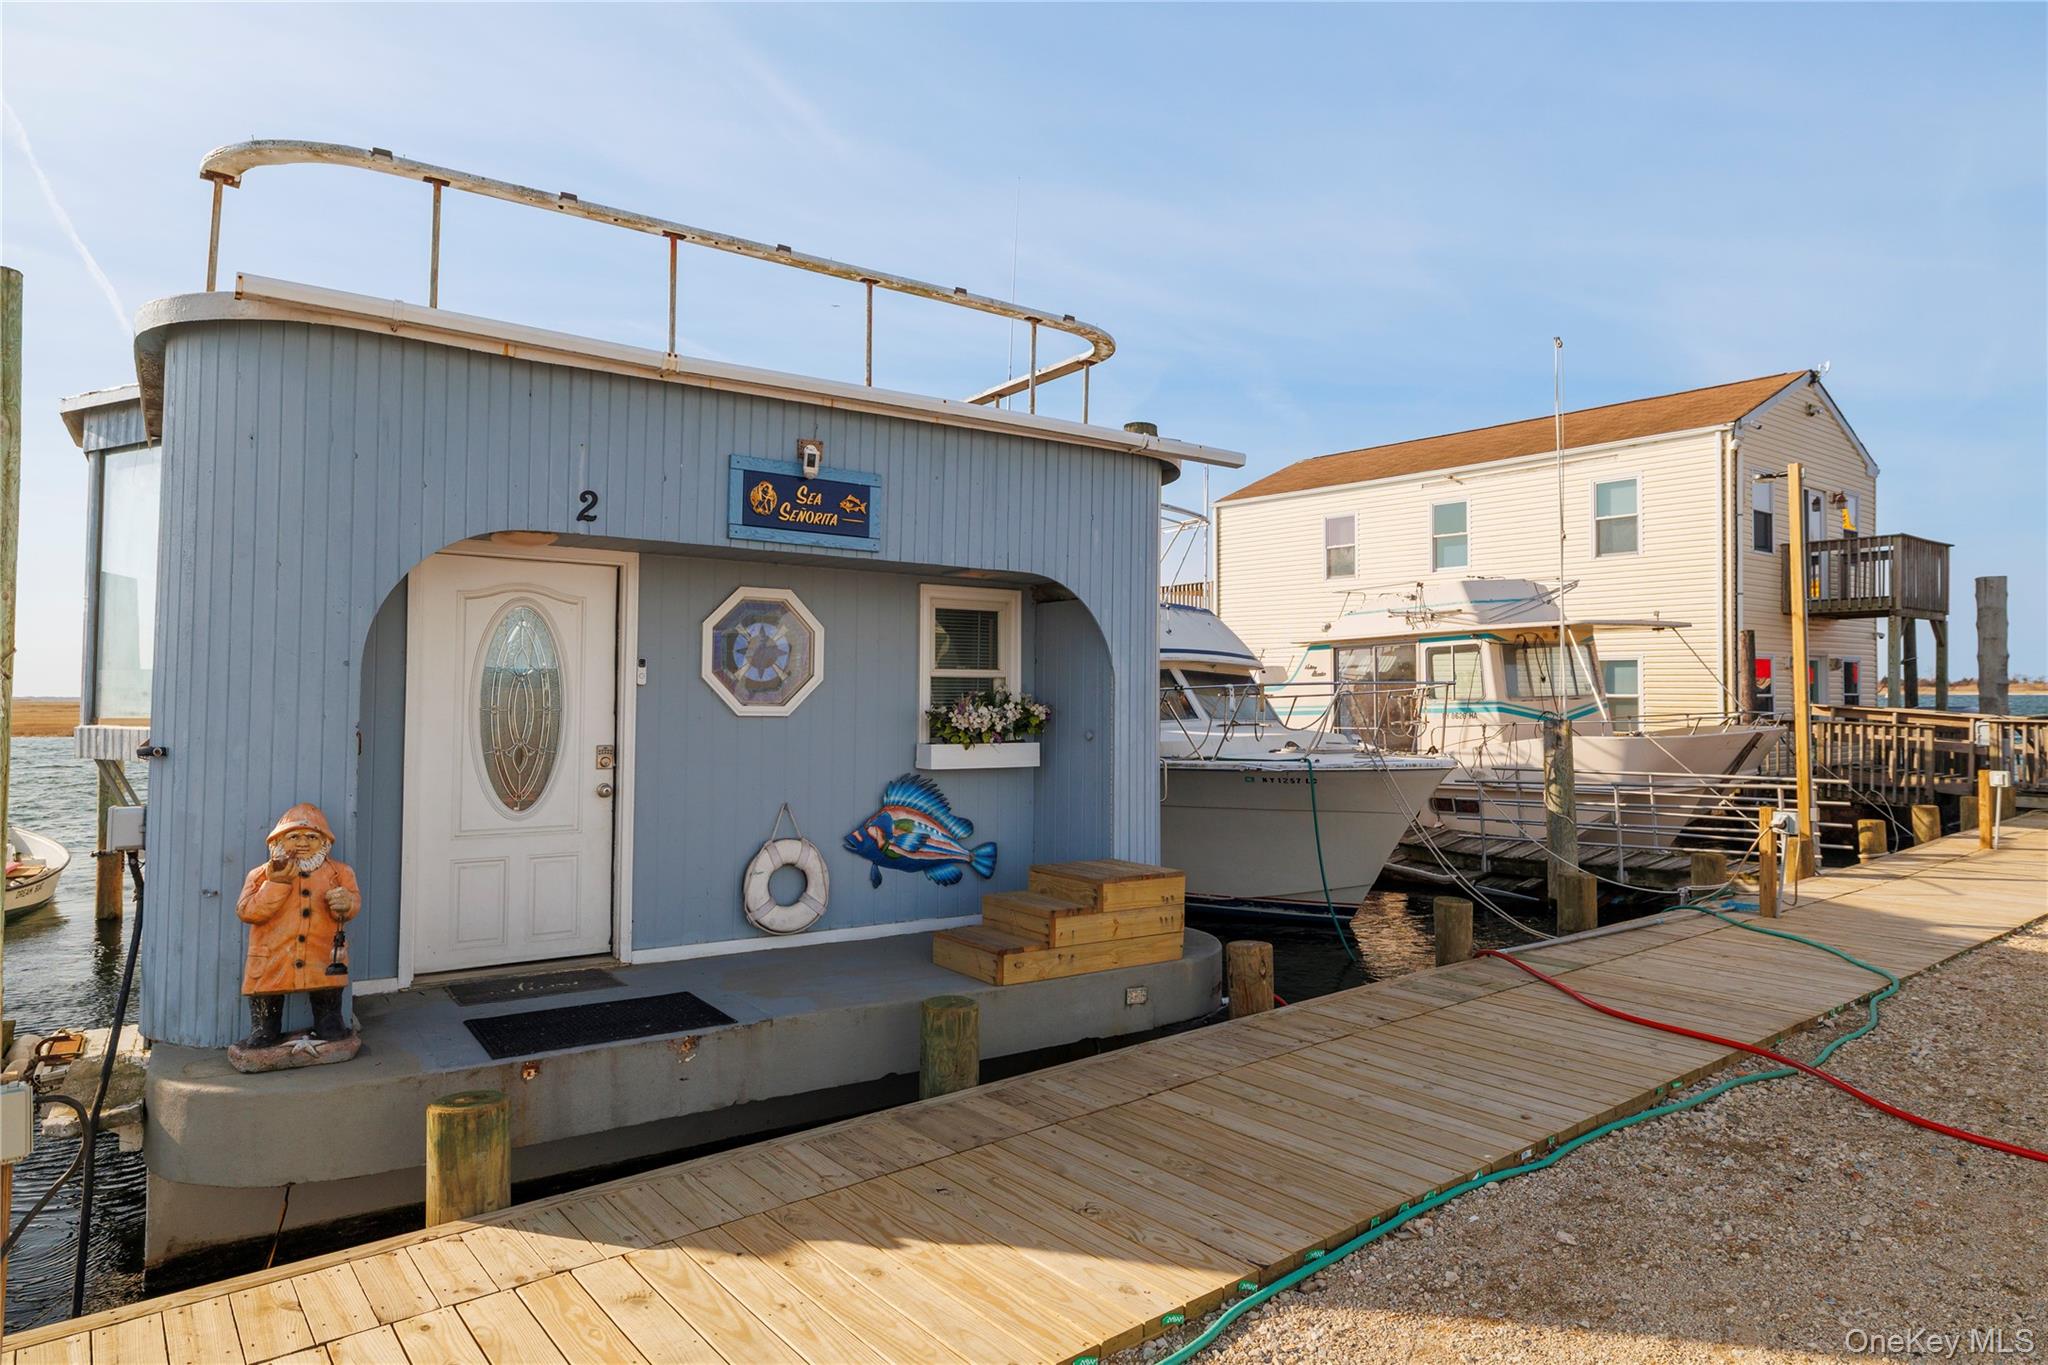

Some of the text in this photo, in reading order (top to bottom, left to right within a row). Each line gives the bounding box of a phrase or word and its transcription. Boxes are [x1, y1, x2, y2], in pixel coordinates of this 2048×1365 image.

[576, 490, 598, 522] 2
[796, 484, 823, 506] SEA
[778, 502, 839, 527] SEÑORITA
